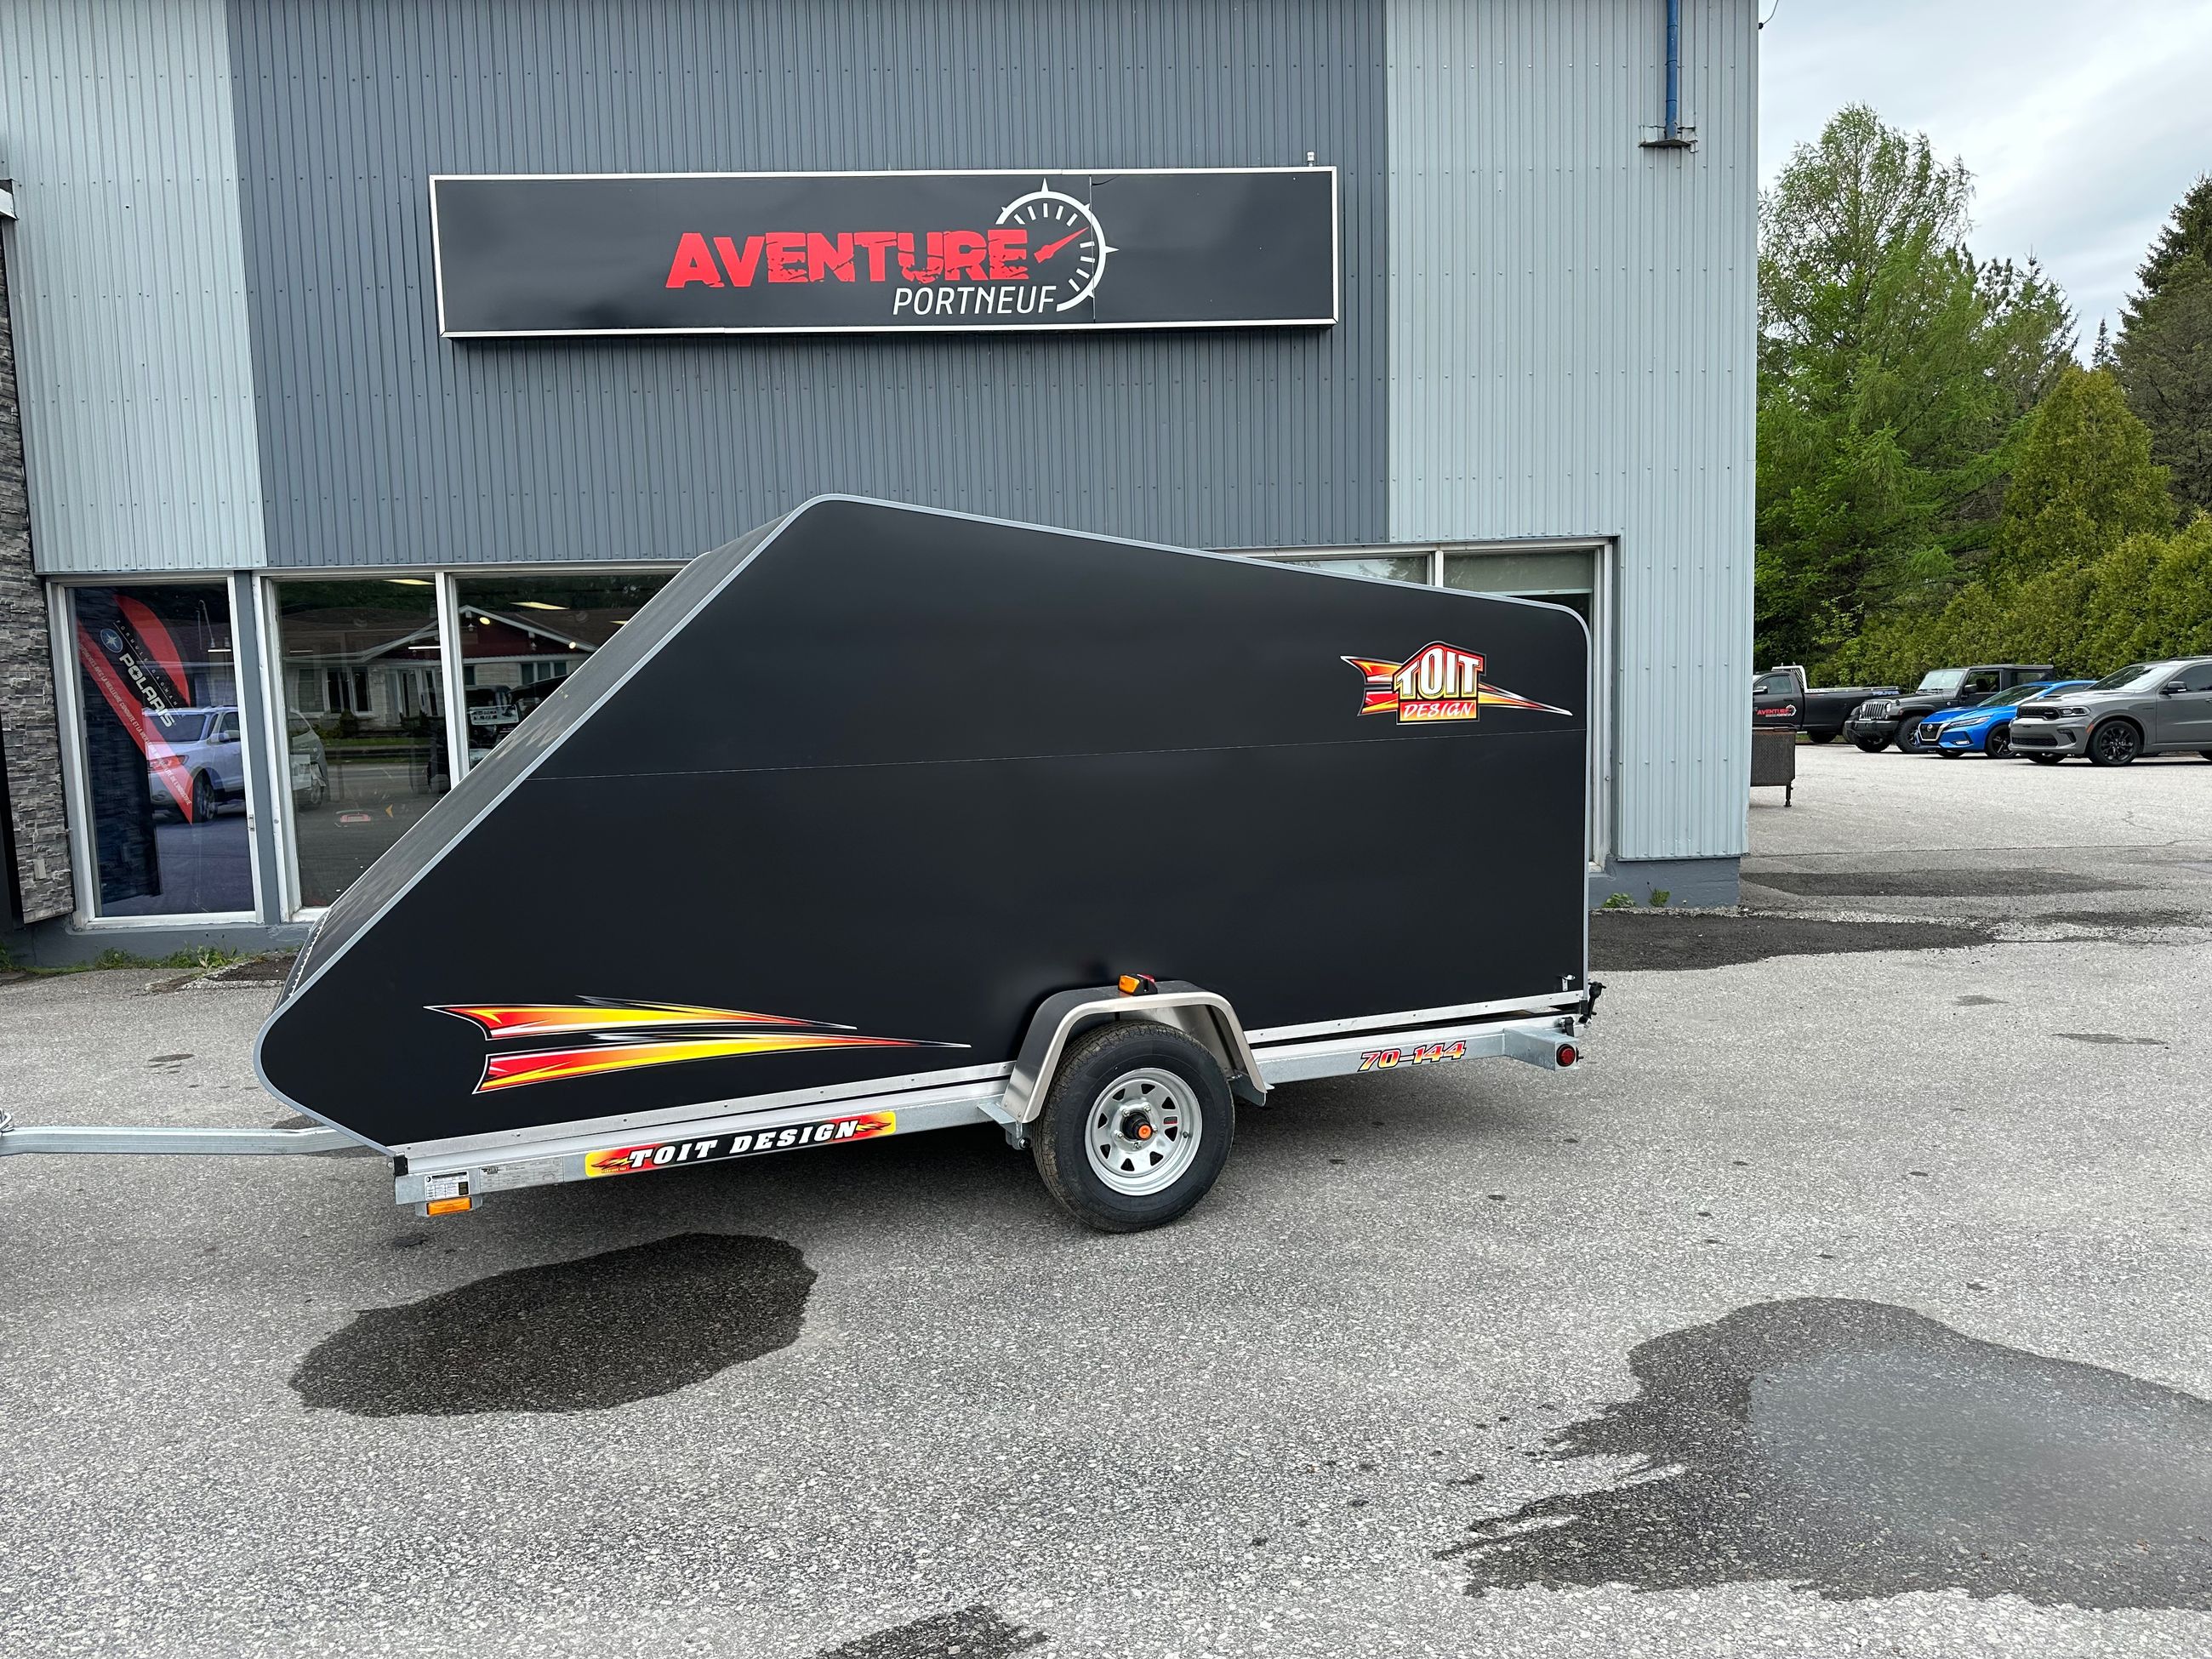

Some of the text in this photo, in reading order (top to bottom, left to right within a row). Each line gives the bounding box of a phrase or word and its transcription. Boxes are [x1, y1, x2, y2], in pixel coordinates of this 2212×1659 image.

[665, 229, 1029, 288] AVENTURE
[892, 285, 1057, 316] PORTNEUF
[119, 653, 175, 727] POLARIS
[1396, 646, 1481, 698] TOIT
[1403, 702, 1473, 718] DESIGN
[1358, 1040, 1467, 1072] 70-144
[629, 1120, 860, 1169] TOIT DESIGN
